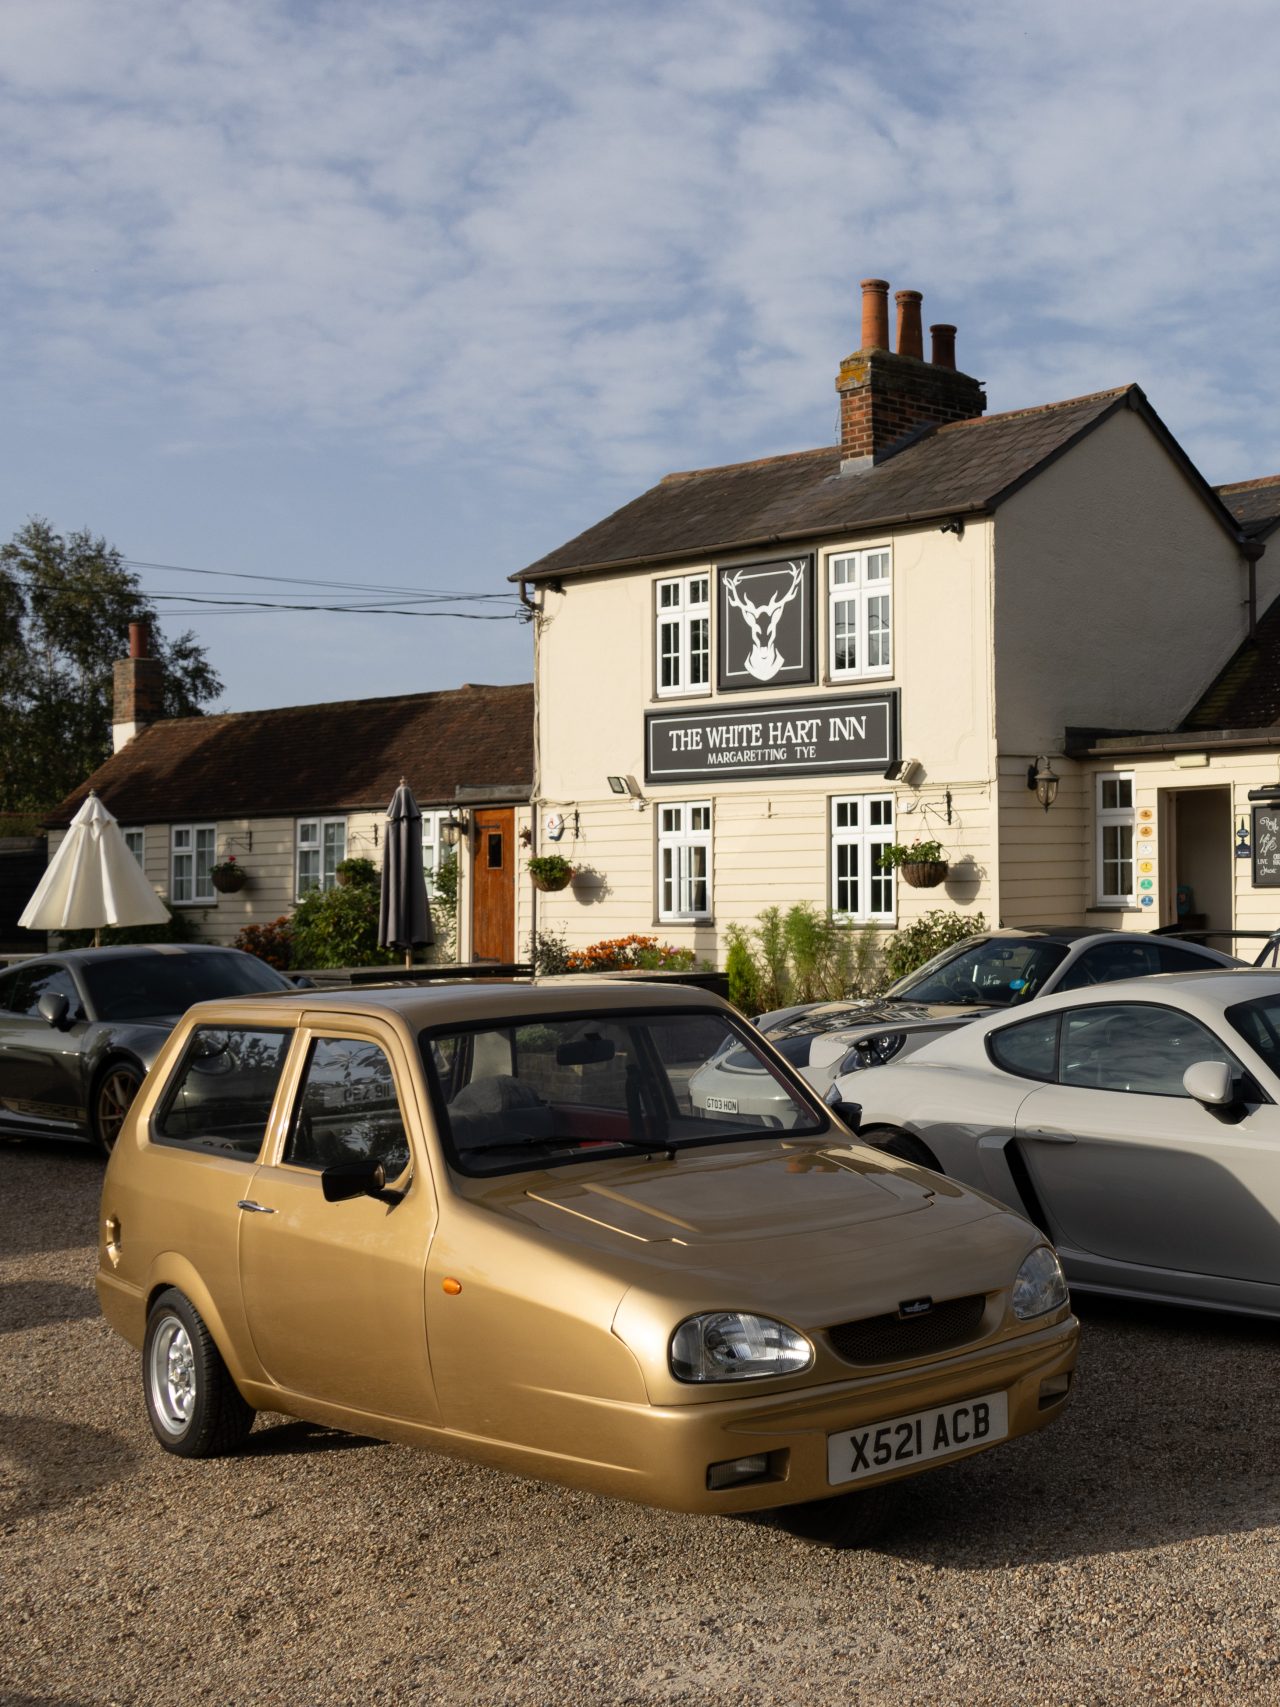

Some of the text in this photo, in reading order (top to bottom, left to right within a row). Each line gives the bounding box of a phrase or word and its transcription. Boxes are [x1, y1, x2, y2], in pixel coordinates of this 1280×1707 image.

[669, 716, 866, 751] THE WHITE HART INN
[708, 746, 816, 765] MARGARETTING TYE
[707, 1098, 722, 1110] GT03
[851, 1402, 990, 1473] X521 ACB
